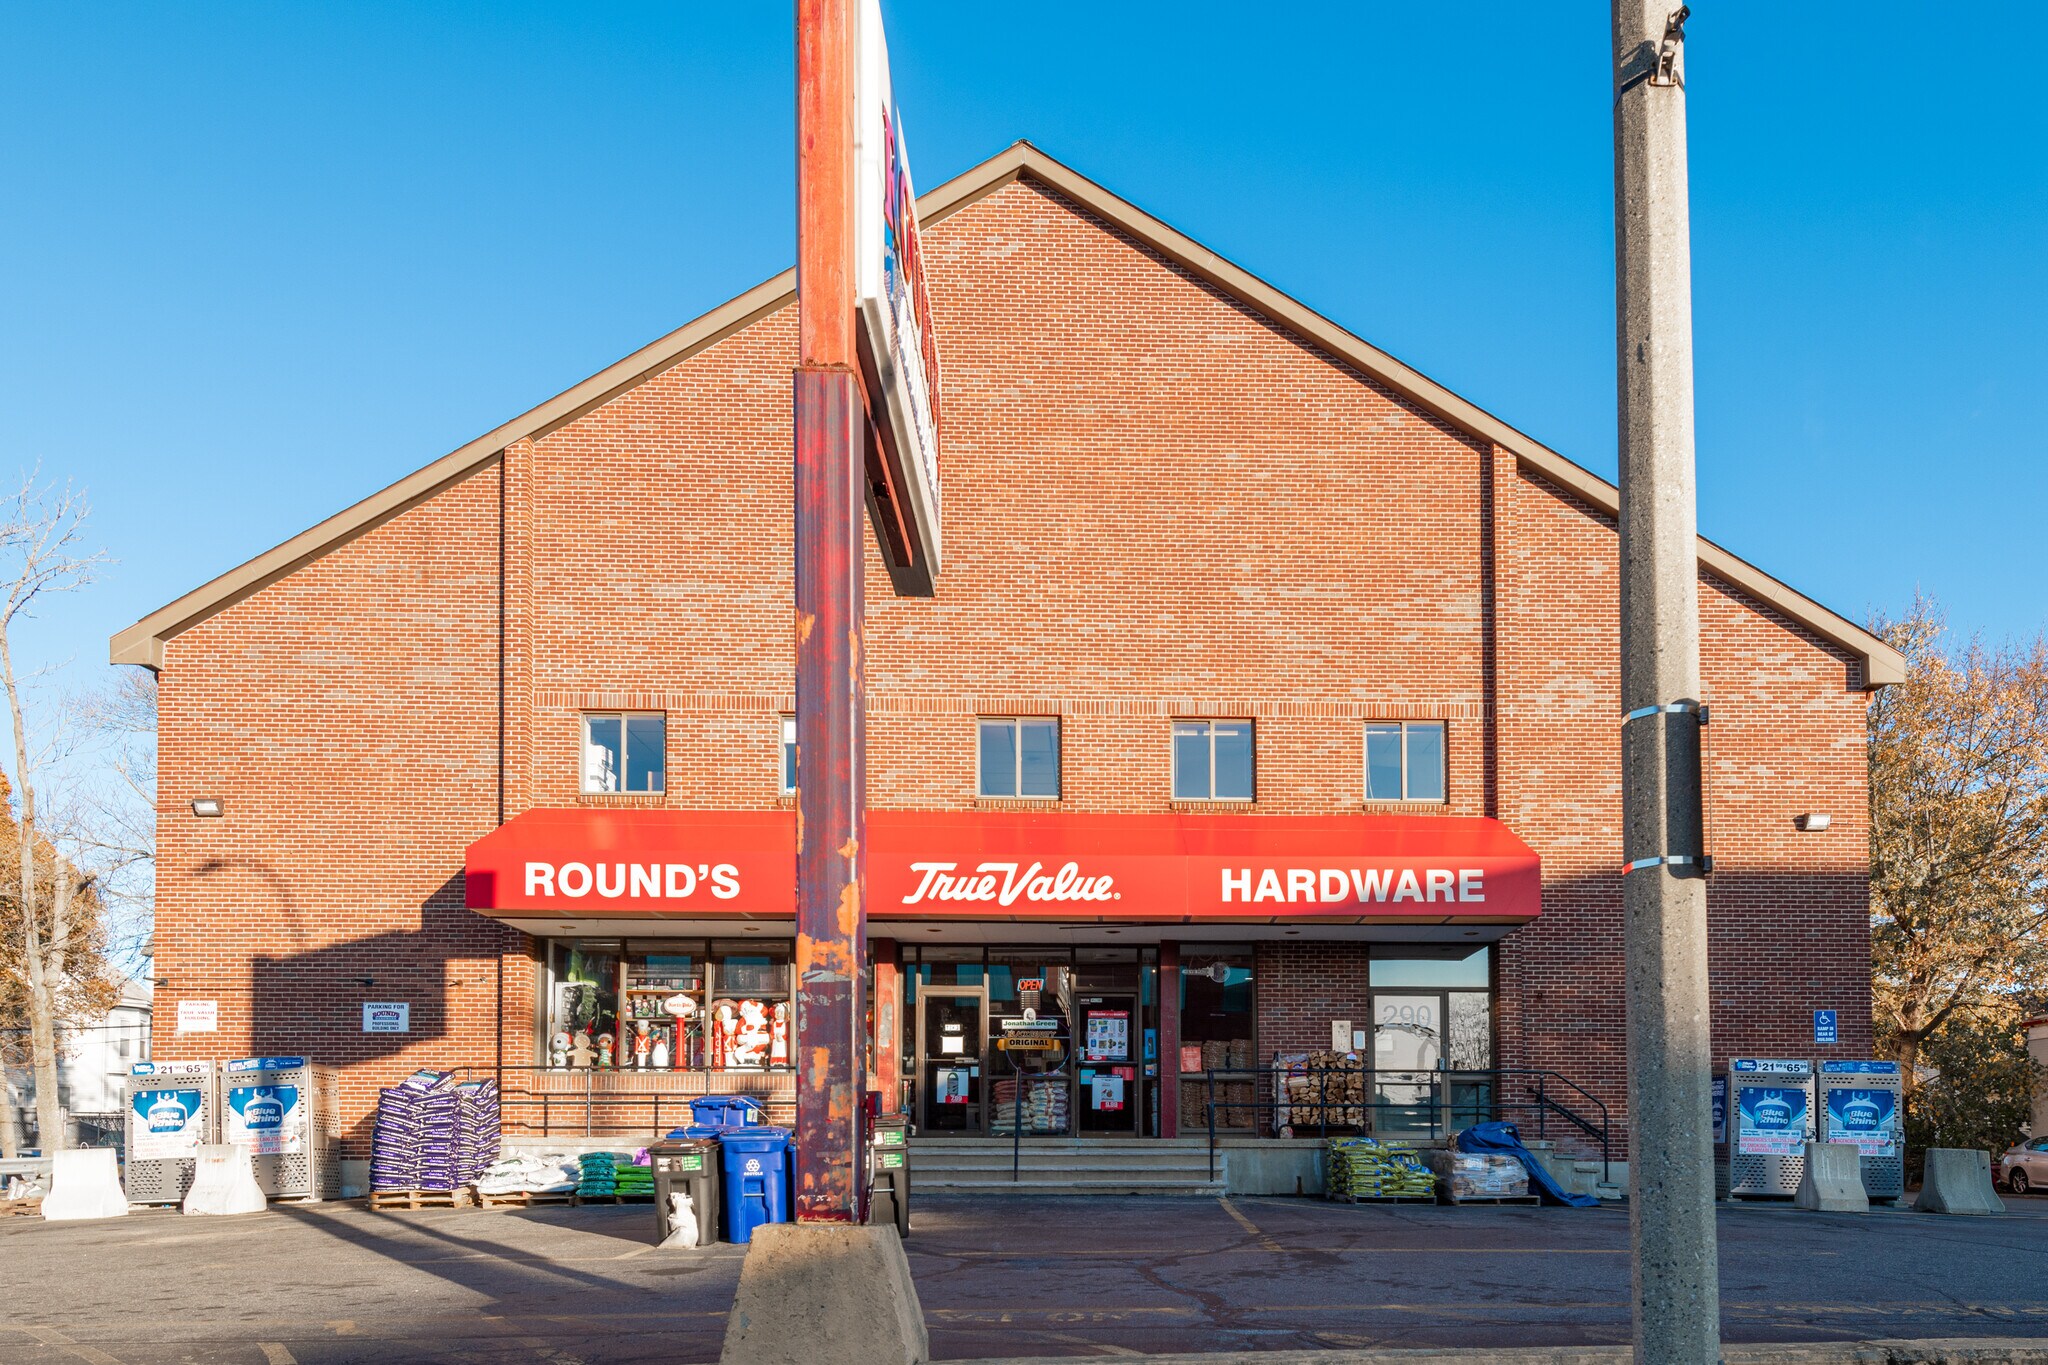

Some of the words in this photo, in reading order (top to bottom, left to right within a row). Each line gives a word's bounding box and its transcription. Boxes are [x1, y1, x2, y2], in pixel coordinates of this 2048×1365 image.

[525, 862, 740, 899] ROUND'S
[902, 861, 996, 905] True
[977, 861, 1116, 906] Value
[1222, 869, 1486, 903] HARDWARE
[1020, 980, 1042, 990] OPEN
[1383, 1005, 1431, 1027] 290
[252, 1115, 280, 1123] Rhino
[1849, 1117, 1877, 1125] Rhino
